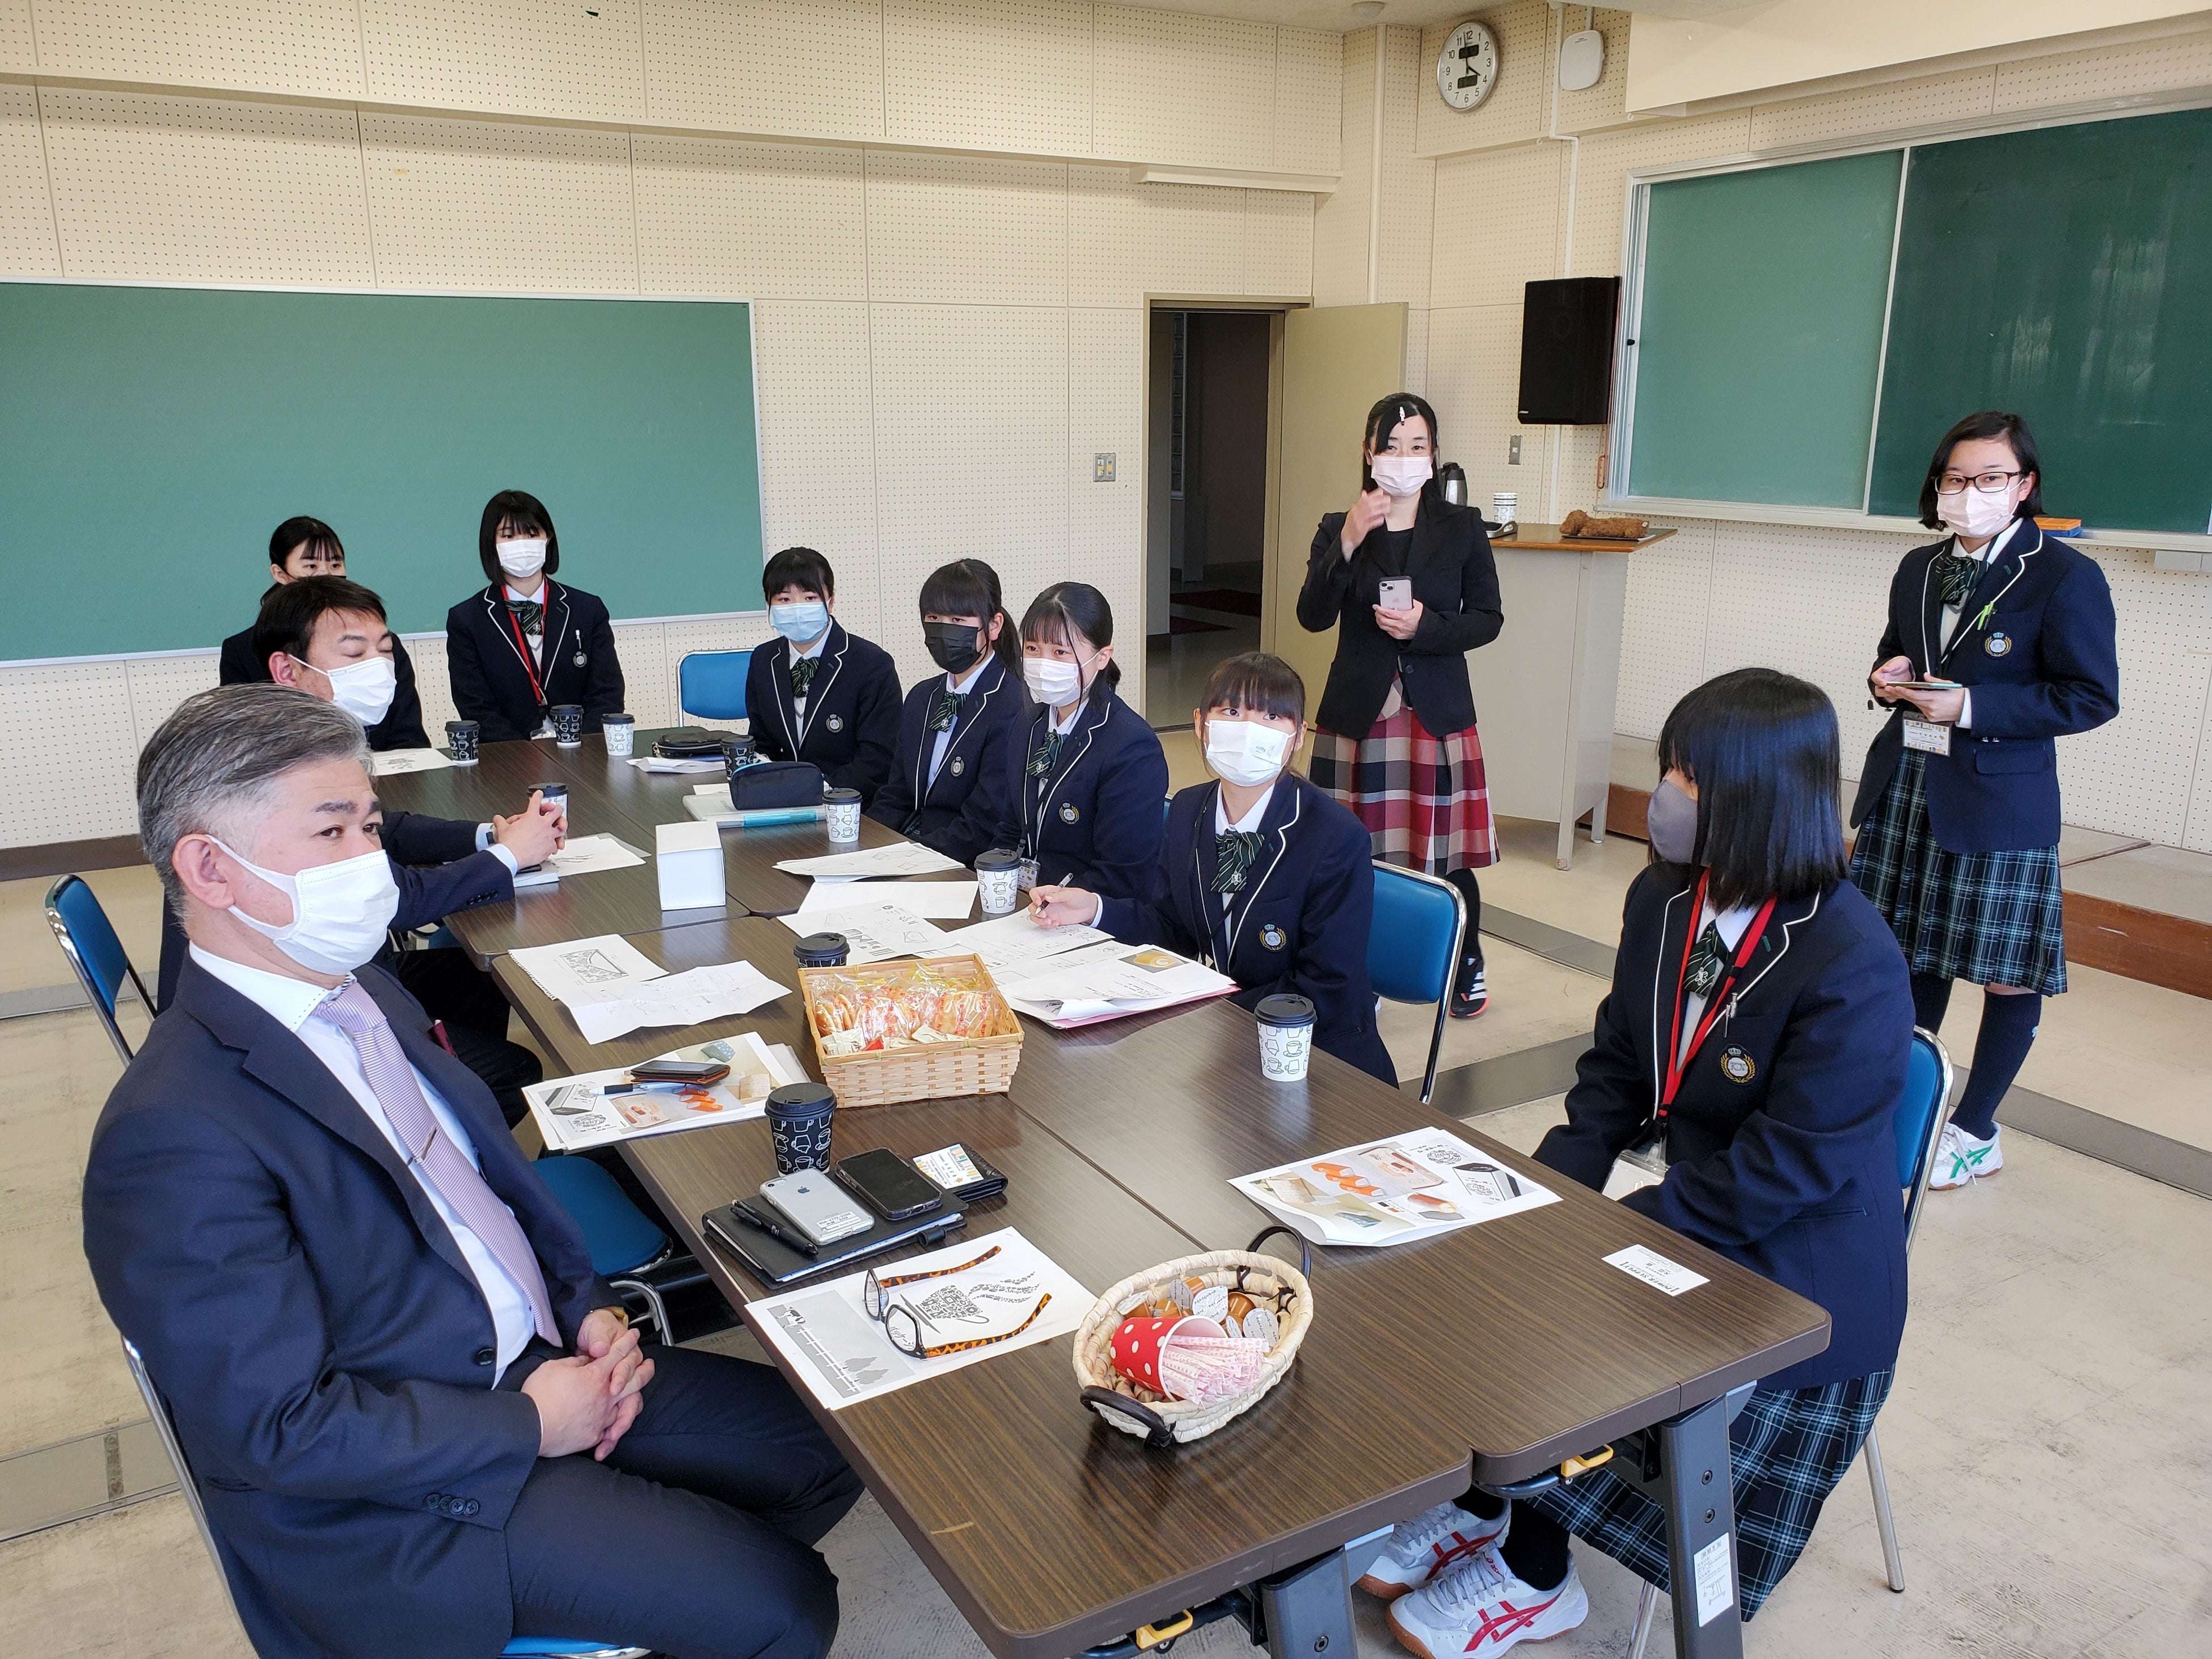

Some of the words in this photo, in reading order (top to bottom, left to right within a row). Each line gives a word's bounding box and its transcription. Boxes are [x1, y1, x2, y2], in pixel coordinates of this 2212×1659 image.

[1466, 31, 1473, 40] 12
[1478, 32, 1481, 41] 1
[1457, 37, 1462, 46] 11
[1484, 41, 1489, 51] 2
[1448, 50, 1455, 60] 10
[1486, 58, 1491, 67] 3
[1446, 66, 1451, 75] 9
[1483, 75, 1487, 83] 4
[1447, 82, 1453, 91] 8
[1455, 92, 1459, 101] 7
[1475, 87, 1480, 97] 5
[1464, 94, 1469, 103] 6
